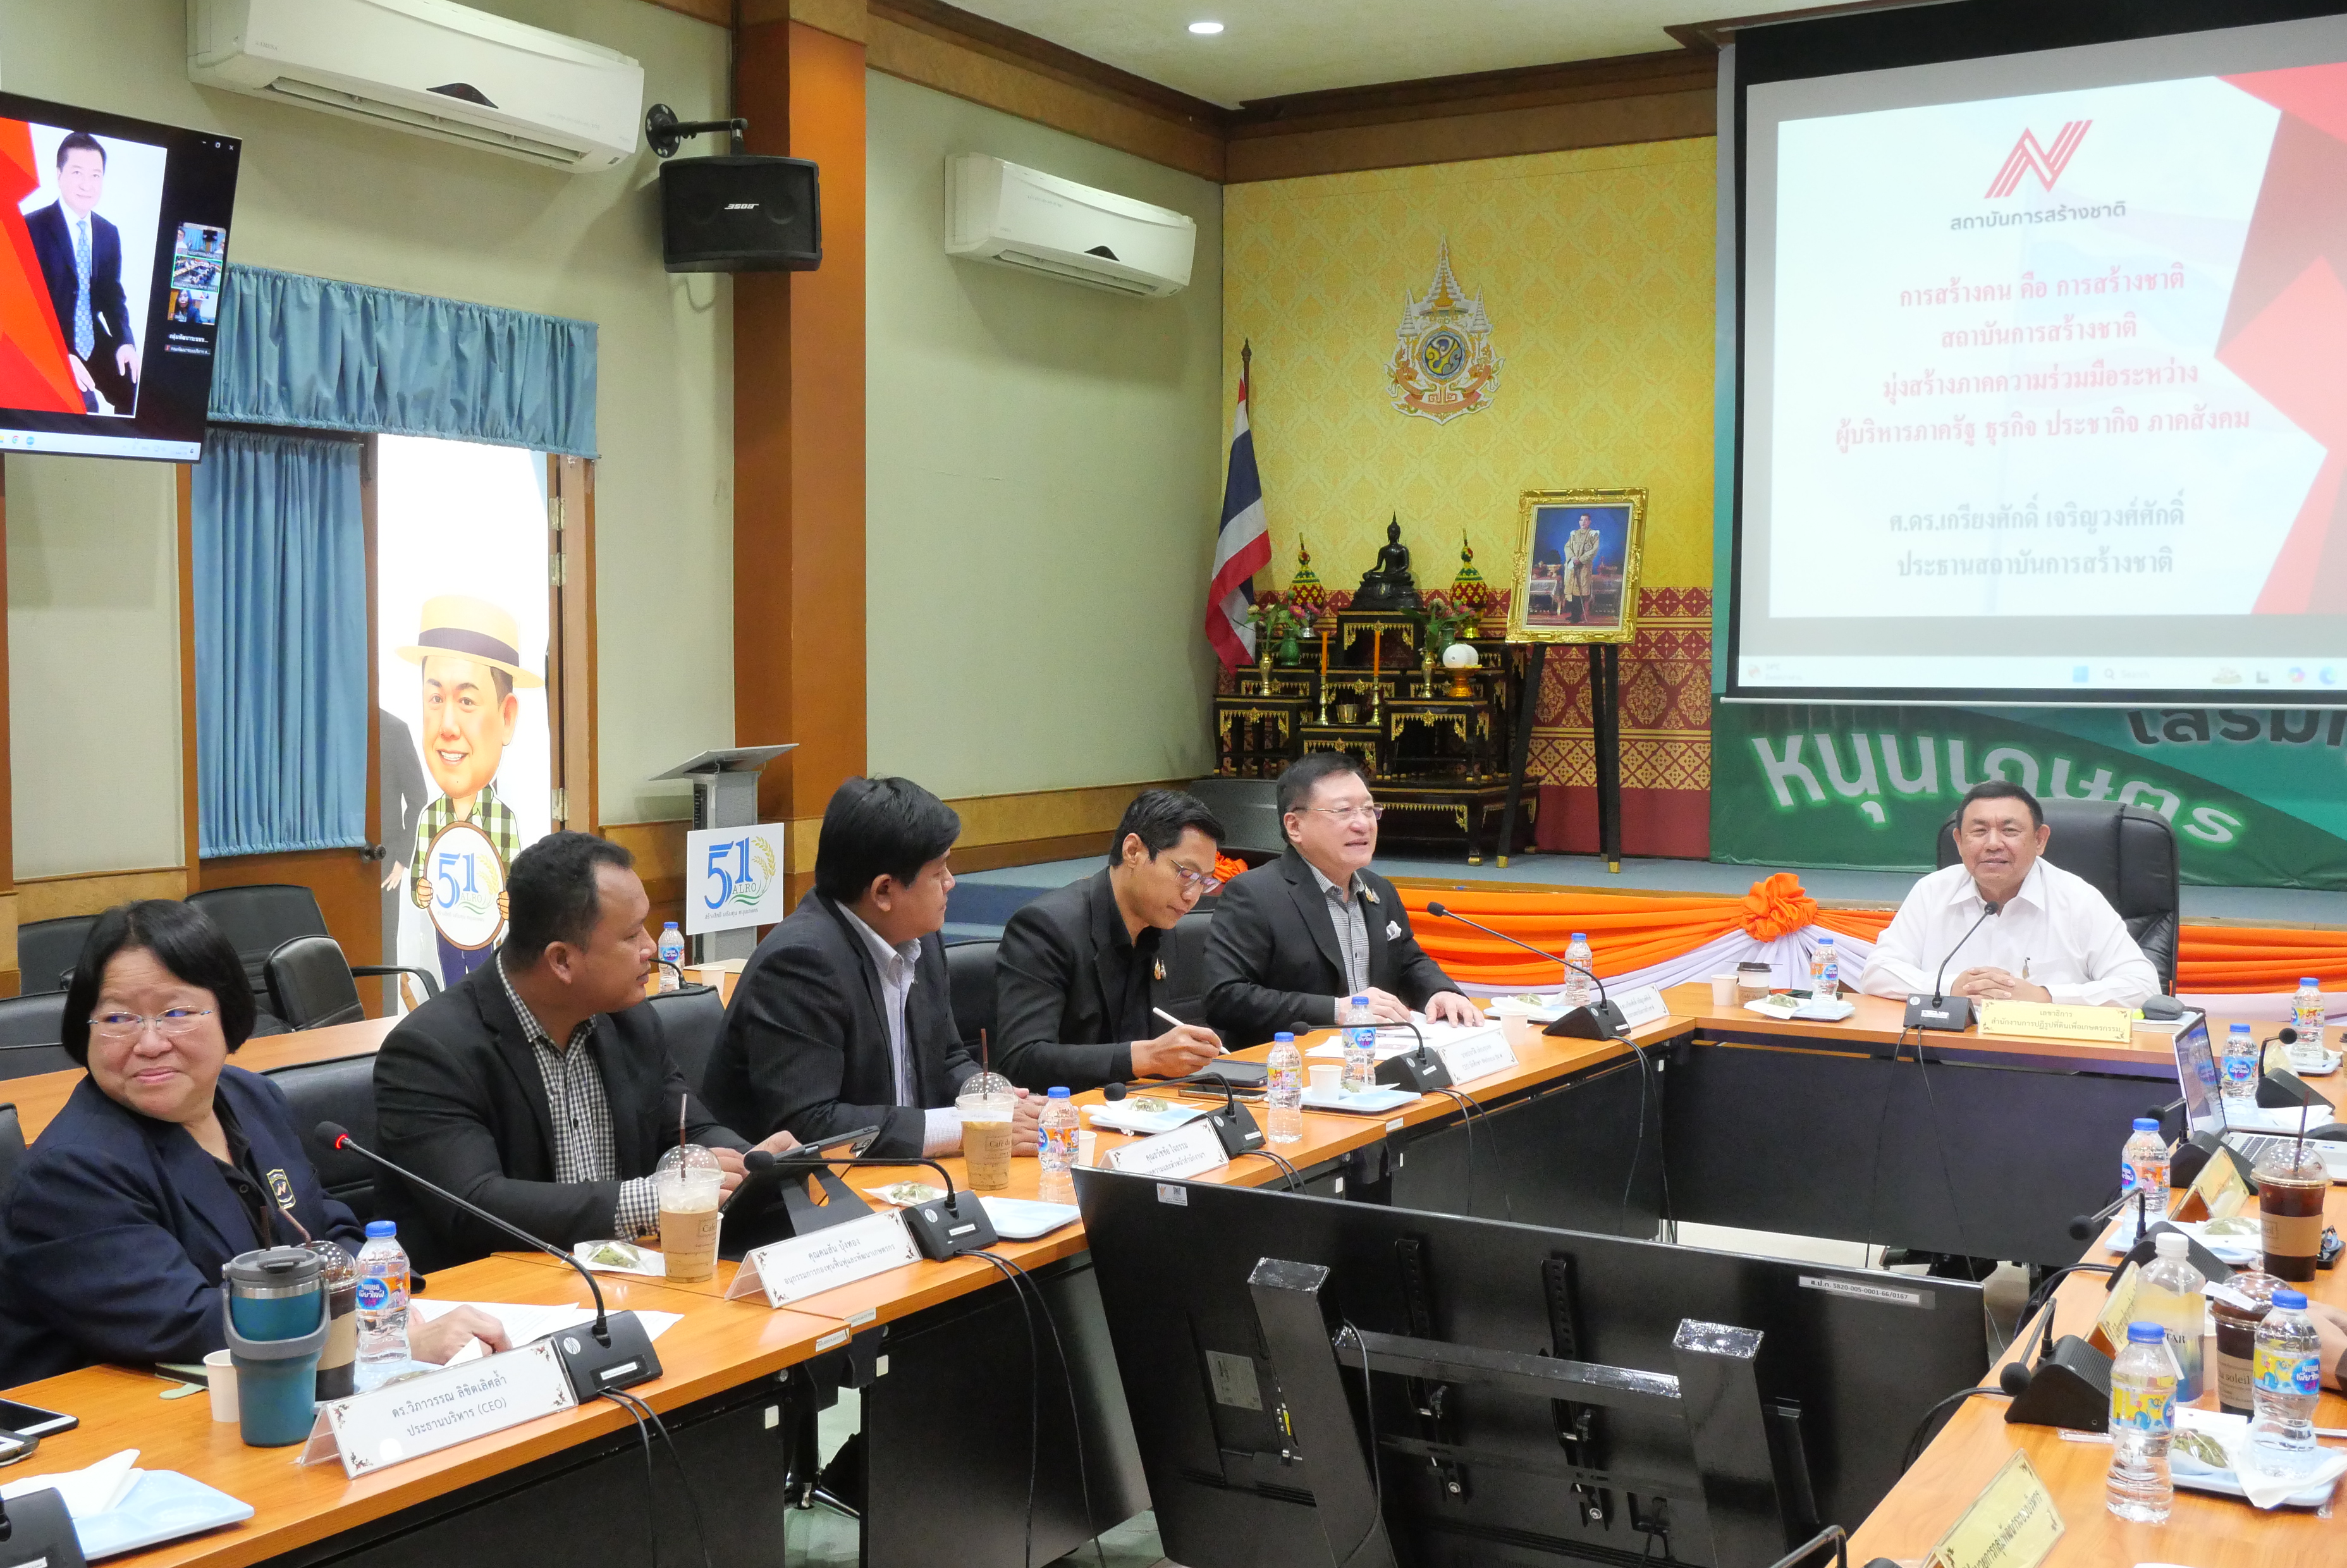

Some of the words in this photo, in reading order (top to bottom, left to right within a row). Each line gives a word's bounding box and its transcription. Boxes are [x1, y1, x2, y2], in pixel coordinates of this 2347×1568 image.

[1950, 200, 2127, 231] สถาบันการสร้างชาติ
[1900, 276, 2012, 308] การสร้างคน
[2019, 270, 2048, 300] คือ
[2056, 262, 2185, 297] การสร้างชาติ
[1940, 311, 2137, 349] สถาบันการสร้างชาติ
[1882, 356, 2198, 406] มุ่งสร้างภาคความร่วมมือระหว่าง
[1835, 413, 1975, 454] ผู้บริหารภาครัฐ
[1985, 410, 2037, 446] ธุรกิจ
[2046, 406, 2139, 438] ประชากิจ
[2148, 402, 2251, 434] ภาคสังคม
[1889, 491, 2040, 533] ศ.ดร.เกรียงศักดิ์
[2045, 487, 2185, 536] เจริญวงศ์ศักดิ์
[1897, 544, 2174, 577] ประธานสถาบันการสร้างชาติ
[436, 852, 479, 909] 51
[704, 836, 753, 909] 51
[732, 882, 757, 895] ALRO
[460, 892, 482, 903] ALRO
[2040, 1009, 2073, 1017] เลขาธิการ
[1833, 1283, 1908, 1300] 5820-005-0001-66/0167
[391, 1392, 455, 1418] ดร.วิภาวรรณ
[457, 1369, 507, 1398] ลิขิตเลิศล้ำ
[2225, 1373, 2250, 1385] soleil
[407, 1407, 475, 1436] ประธานบริหาร
[477, 1397, 506, 1416] (CEO)
